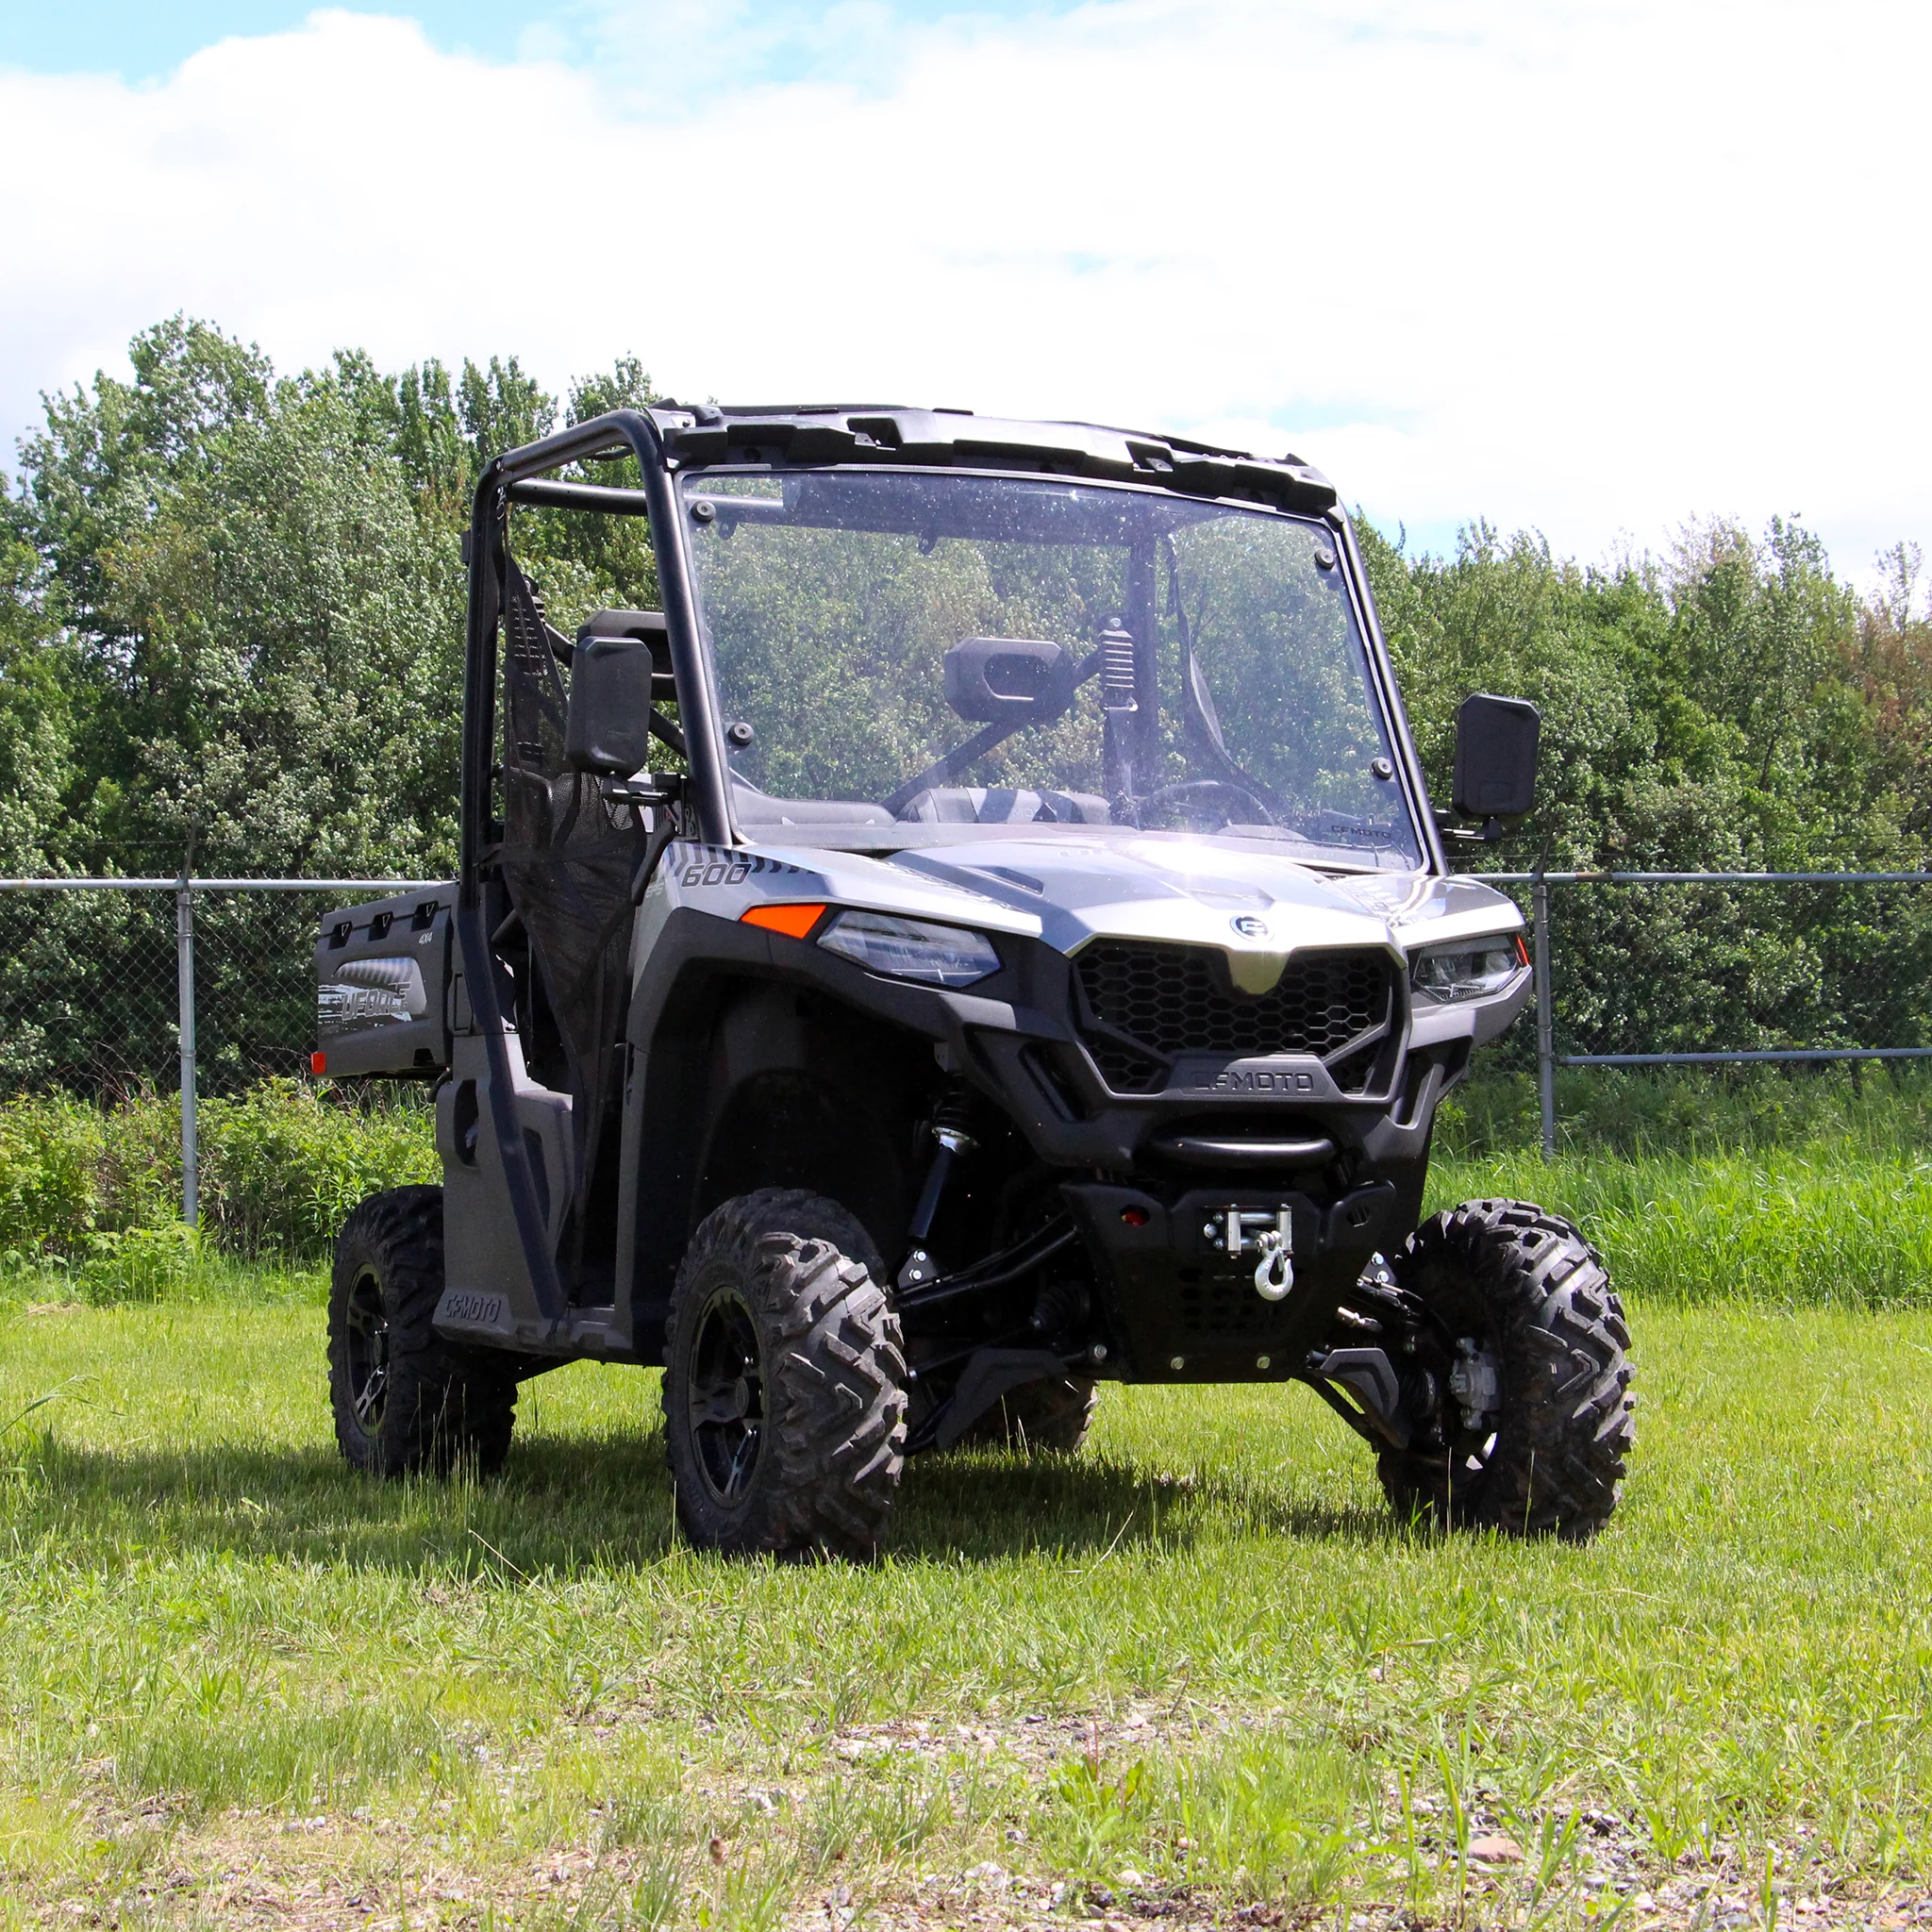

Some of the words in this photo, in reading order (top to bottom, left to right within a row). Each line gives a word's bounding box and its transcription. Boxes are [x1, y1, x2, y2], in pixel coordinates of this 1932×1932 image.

[1331, 824, 1391, 839] CFMOTO
[680, 861, 752, 889] 600
[1191, 1072, 1313, 1091] CFMOTO
[444, 1294, 502, 1323] CFMOTO
